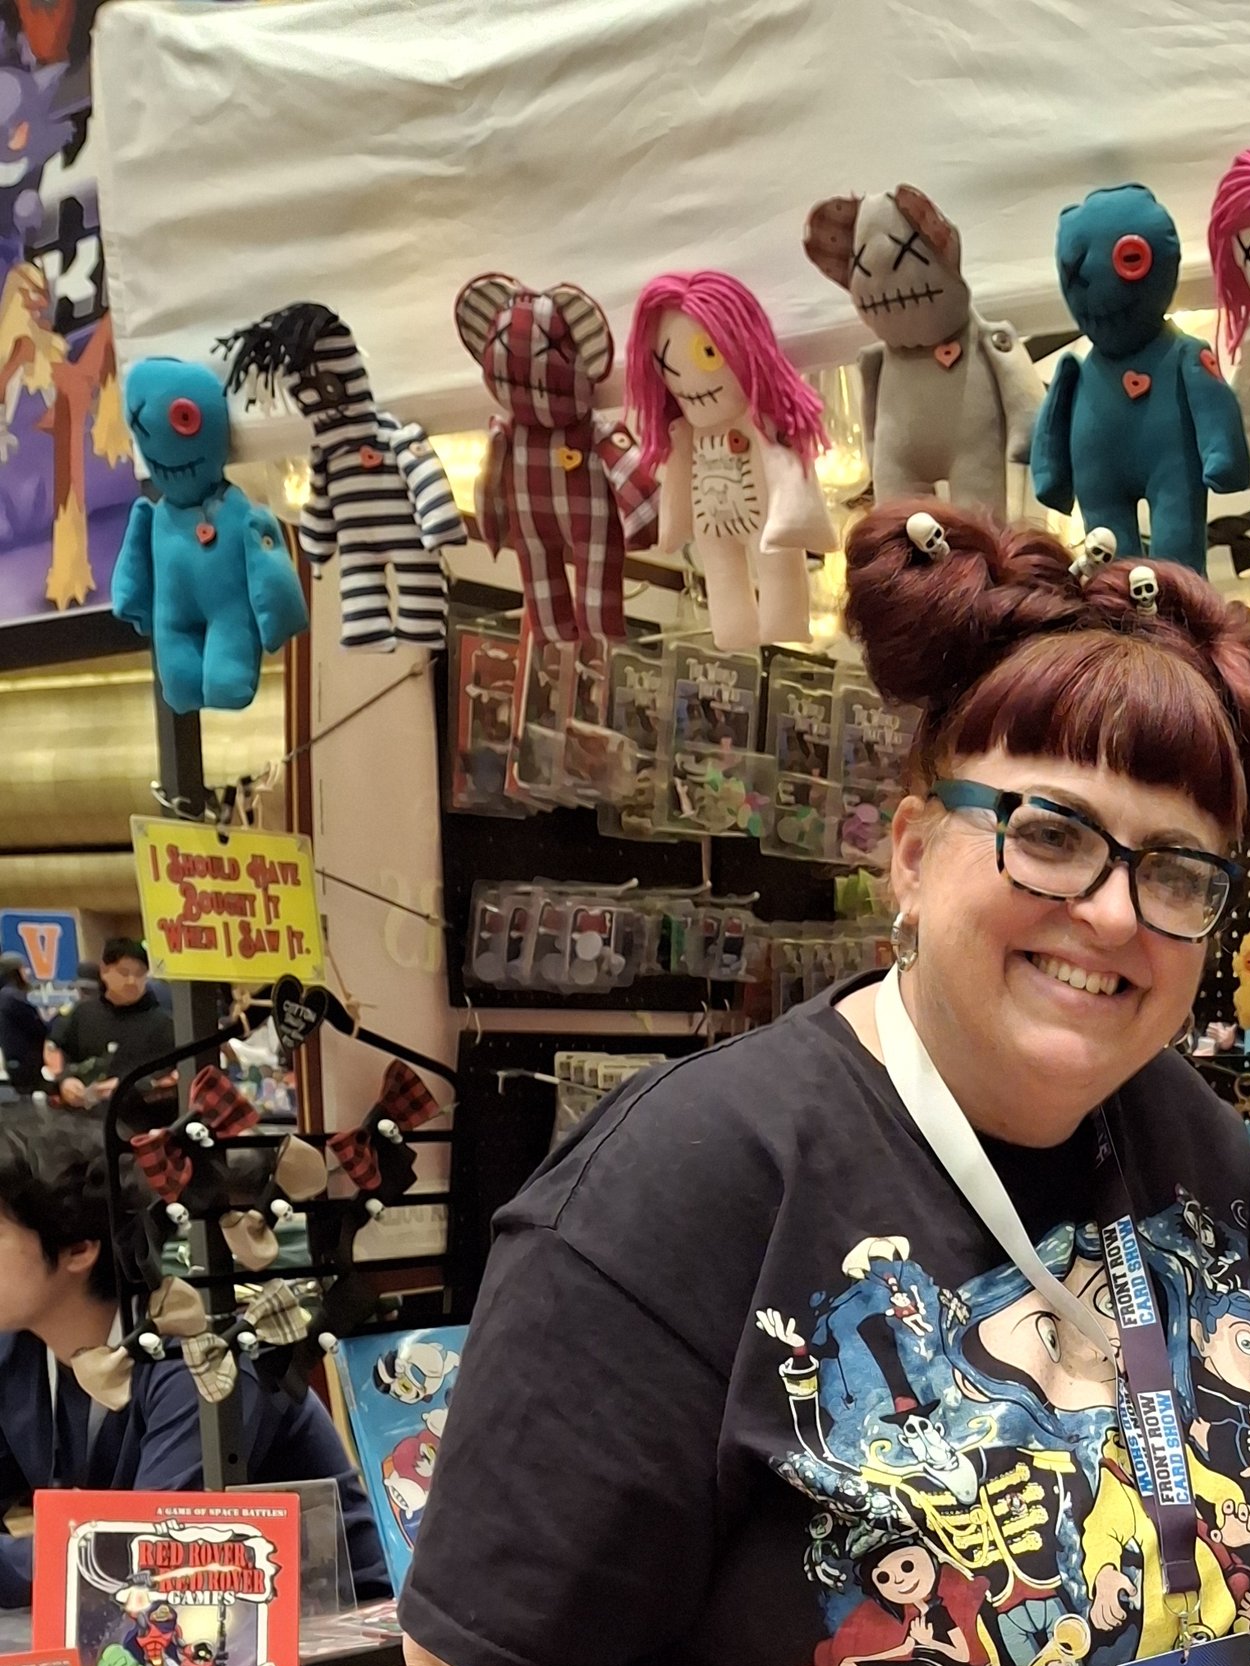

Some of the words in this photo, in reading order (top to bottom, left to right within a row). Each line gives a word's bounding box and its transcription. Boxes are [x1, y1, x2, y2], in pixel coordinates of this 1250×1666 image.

[149, 844, 160, 881] I
[166, 844, 240, 884] SHOULD
[180, 881, 256, 921] BOUGHT
[262, 886, 280, 925] IT
[17, 922, 62, 980] V
[157, 914, 218, 953] WHEN
[223, 921, 232, 957] I
[238, 920, 280, 959] SAW
[1103, 1227, 1124, 1270] ROW
[1117, 1219, 1142, 1273] SHOW
[1112, 1272, 1138, 1326] FRONT
[1131, 1275, 1154, 1324] CARD
[1139, 1395, 1162, 1438] ROW
[1156, 1393, 1179, 1448] SHOW
[1151, 1443, 1174, 1503] FRONT
[1170, 1454, 1189, 1504] CARD
[165, 1507, 191, 1516] GAME
[194, 1508, 207, 1516] OF
[209, 1508, 239, 1517] SPACE
[242, 1509, 287, 1517] BATTLES!
[138, 1540, 184, 1566] RED
[158, 1568, 204, 1593] RED
[208, 1568, 266, 1594] ROVER
[167, 1590, 236, 1606] GAMES
